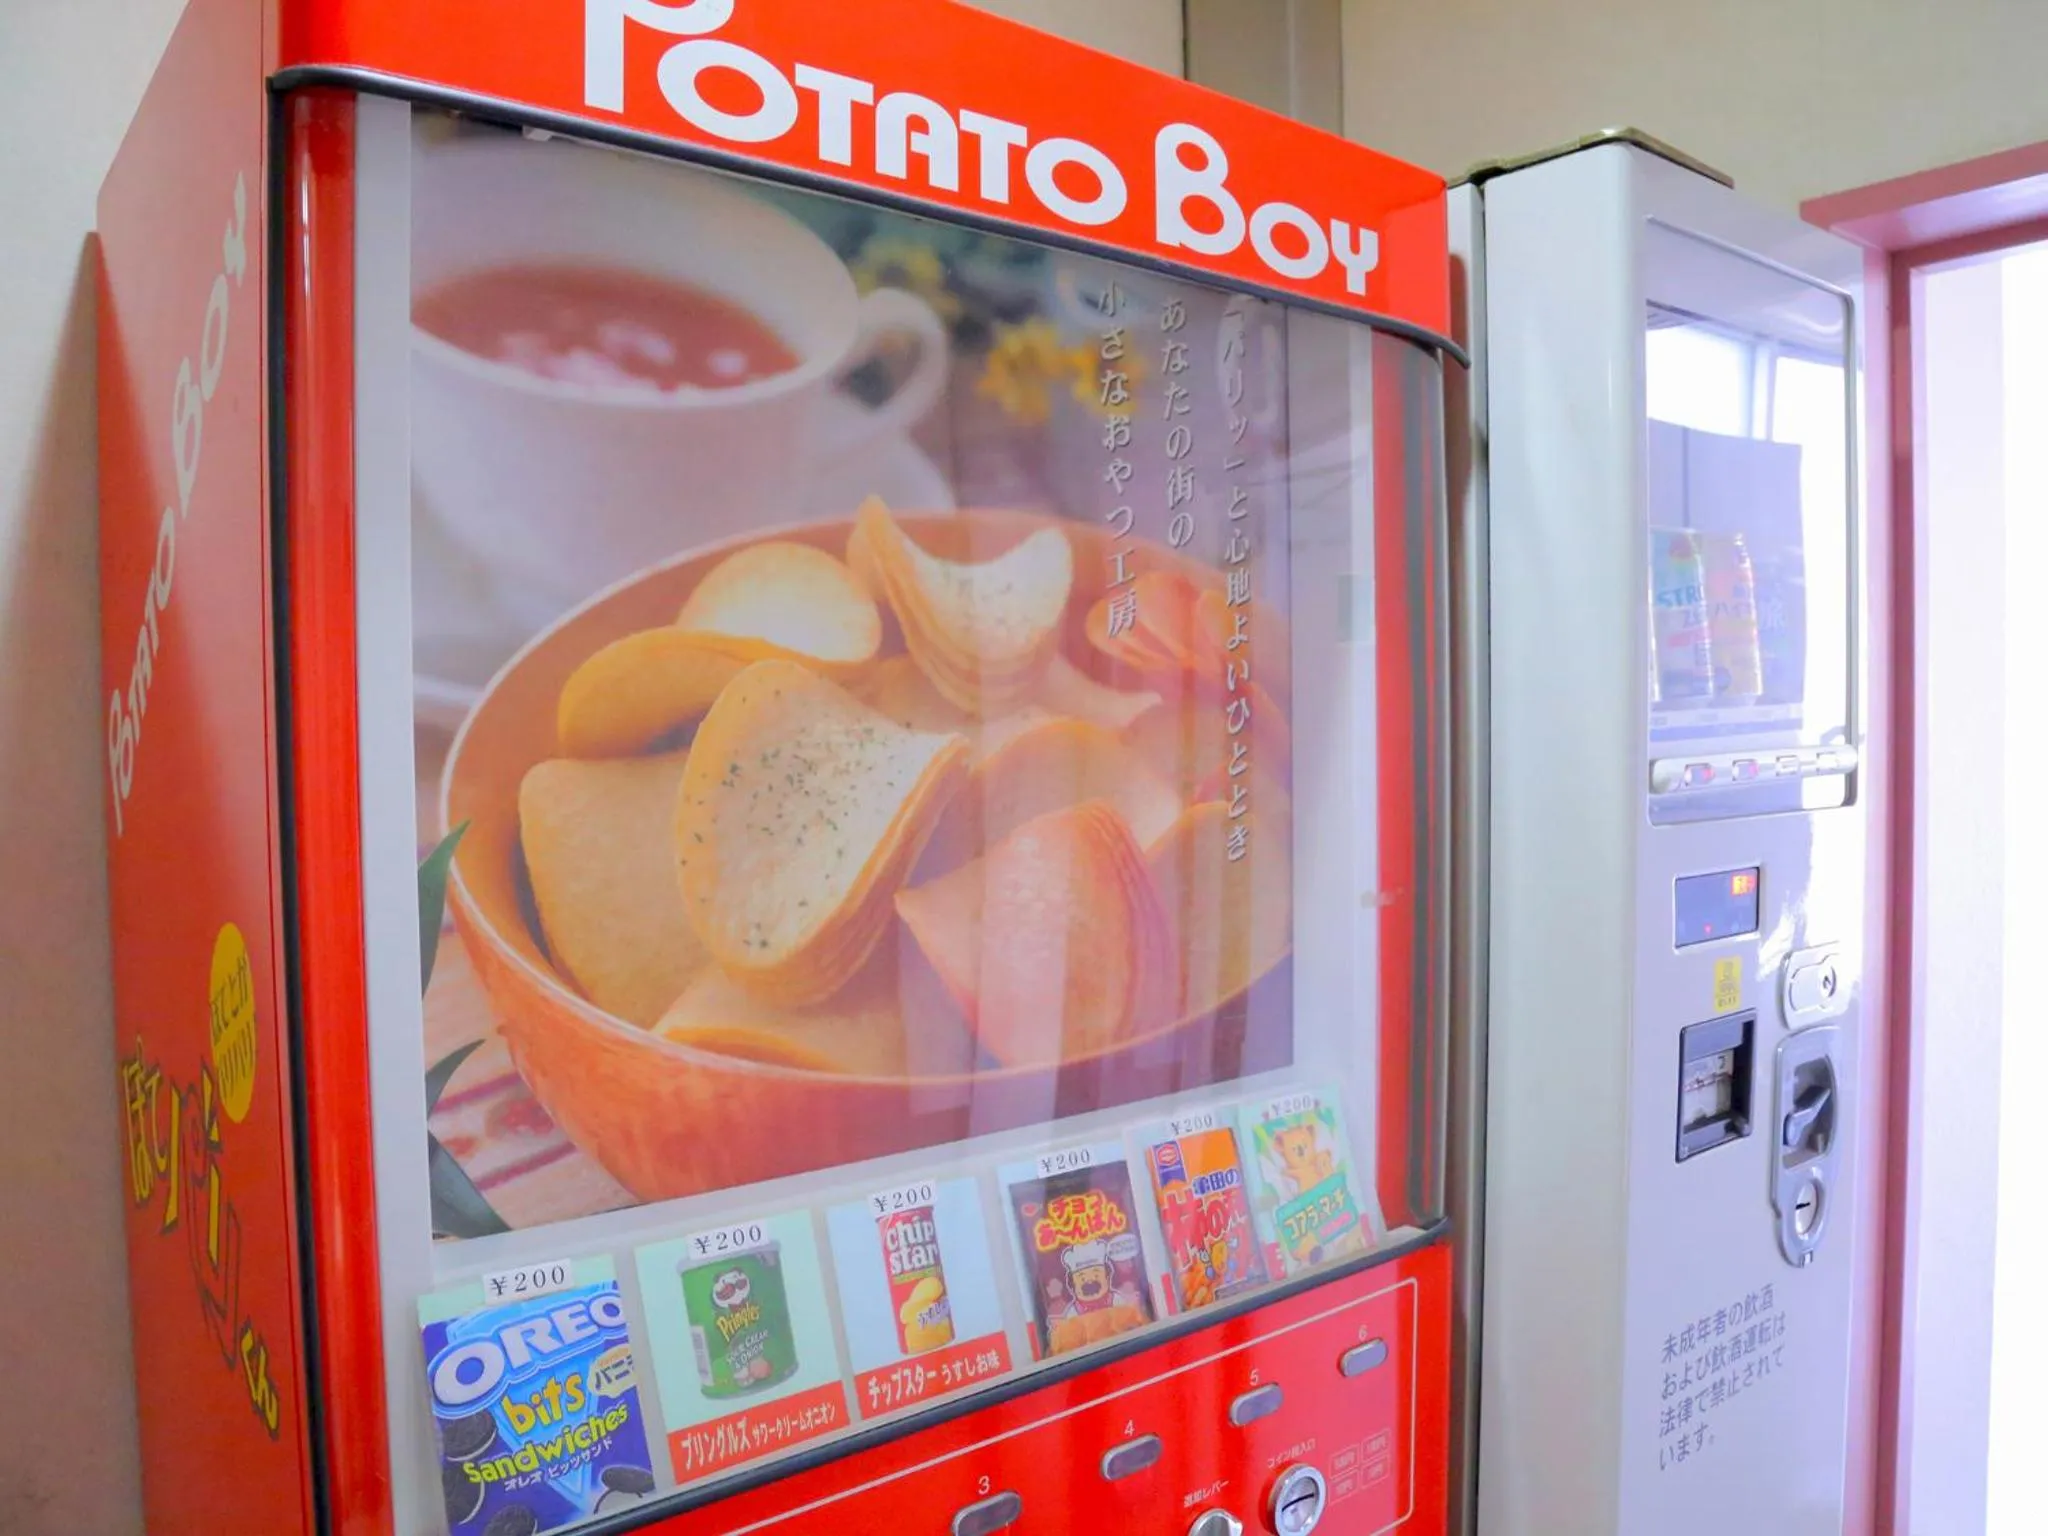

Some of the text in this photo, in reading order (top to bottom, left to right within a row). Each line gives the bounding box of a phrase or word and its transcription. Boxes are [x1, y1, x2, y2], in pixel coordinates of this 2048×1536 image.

[1160, 299, 1196, 549] あなたの街の
[1099, 282, 1138, 637] 小さなおやつ工房
[1171, 1115, 1213, 1136] ¥200
[1042, 1149, 1090, 1173] ¥200
[875, 1185, 933, 1213] ¥200
[694, 1225, 763, 1255] ¥200
[885, 1214, 935, 1250] chip
[889, 1243, 937, 1276] star
[490, 1264, 566, 1297] ¥200
[716, 1302, 761, 1343] Pringles
[1357, 1325, 1368, 1341] 6
[433, 1294, 627, 1405] OREO
[868, 1349, 1000, 1410] チップスター うすしお味
[1249, 1369, 1260, 1385] 5
[1658, 1344, 1785, 1438] 法律で禁止されて
[501, 1371, 587, 1436] bits
[462, 1402, 630, 1484] Sandwiches
[1123, 1419, 1136, 1437] 4
[503, 1470, 544, 1492] オレオ
[978, 1474, 991, 1494] 3
